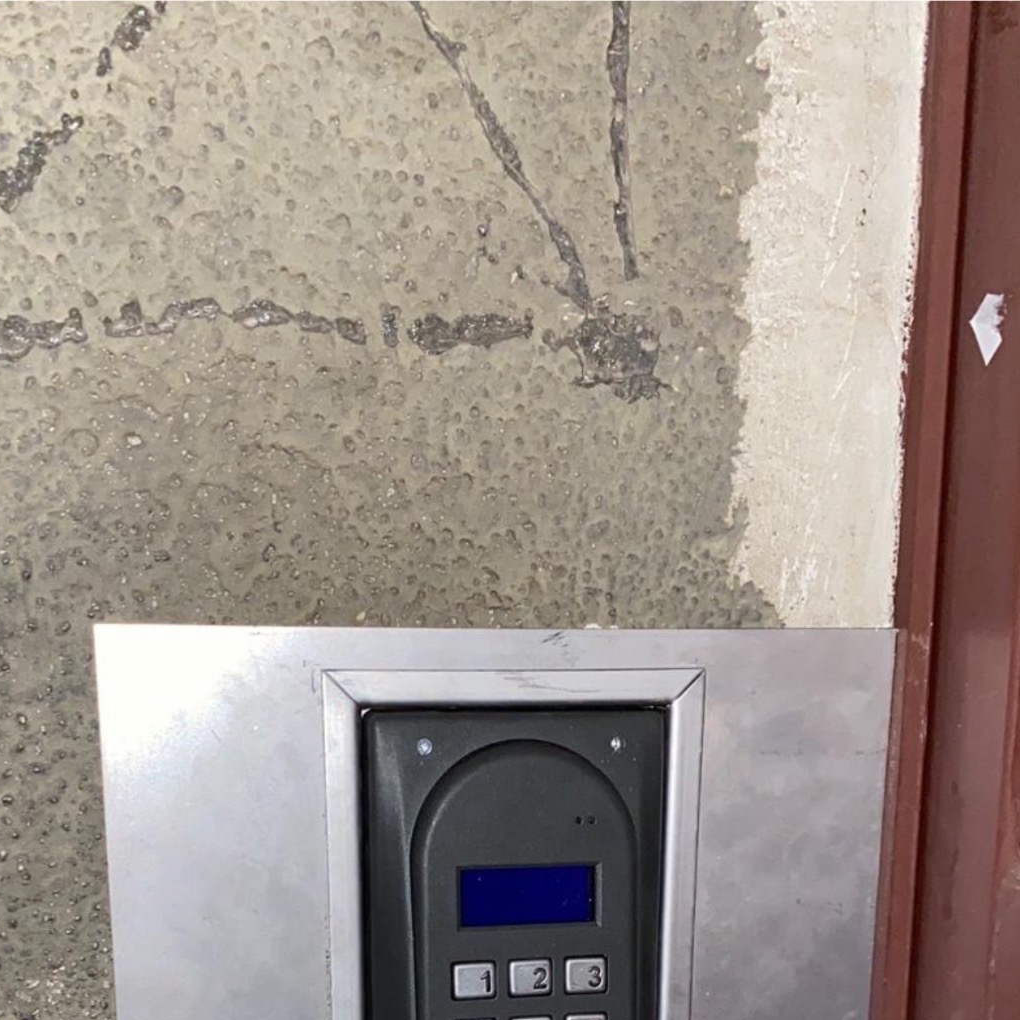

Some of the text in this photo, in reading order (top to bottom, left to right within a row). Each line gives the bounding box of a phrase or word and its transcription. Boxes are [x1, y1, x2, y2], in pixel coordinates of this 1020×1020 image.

[480, 969, 492, 993] 1
[533, 967, 548, 990] 2
[587, 965, 602, 988] 3
